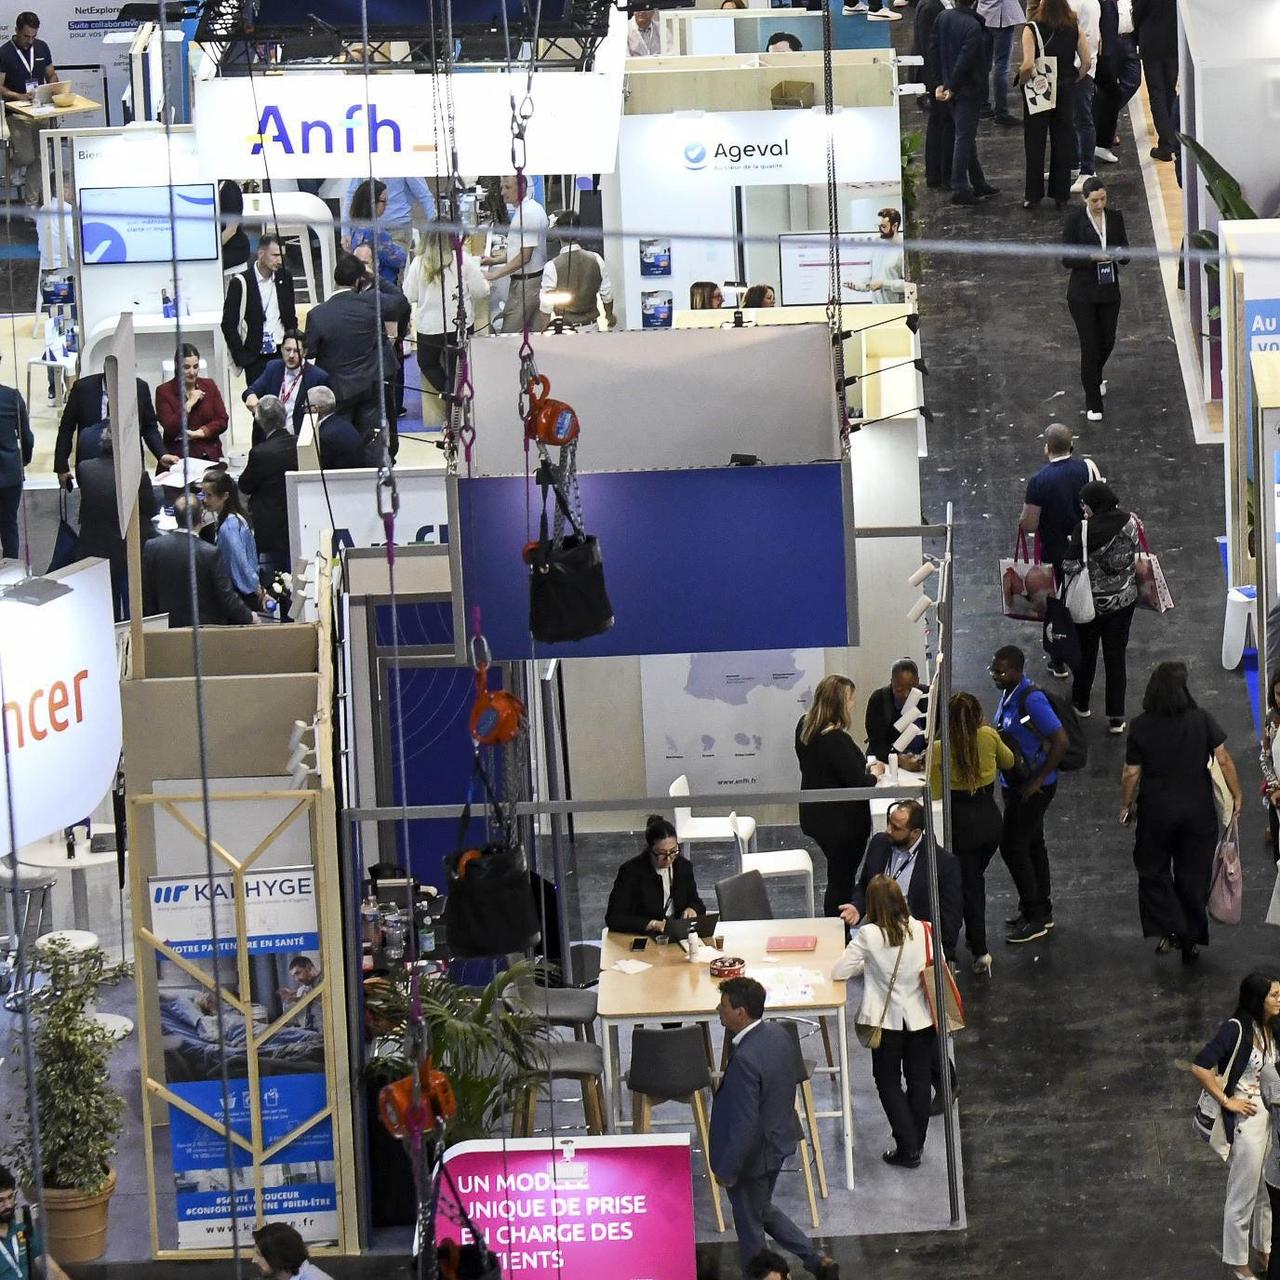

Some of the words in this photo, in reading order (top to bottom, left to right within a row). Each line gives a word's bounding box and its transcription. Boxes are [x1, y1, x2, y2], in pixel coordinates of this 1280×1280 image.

[250, 103, 403, 156] Anfh
[713, 138, 789, 163] Ageval
[1251, 313, 1277, 332] Au
[194, 876, 314, 902] KAHYGE
[260, 939, 273, 948] EN
[275, 936, 305, 947] SANTÉ
[457, 1175, 490, 1194] UN
[551, 1198, 581, 1217] DE
[585, 1194, 648, 1216] PRISE
[496, 1223, 587, 1246] CHARGE
[591, 1221, 634, 1242] DES
